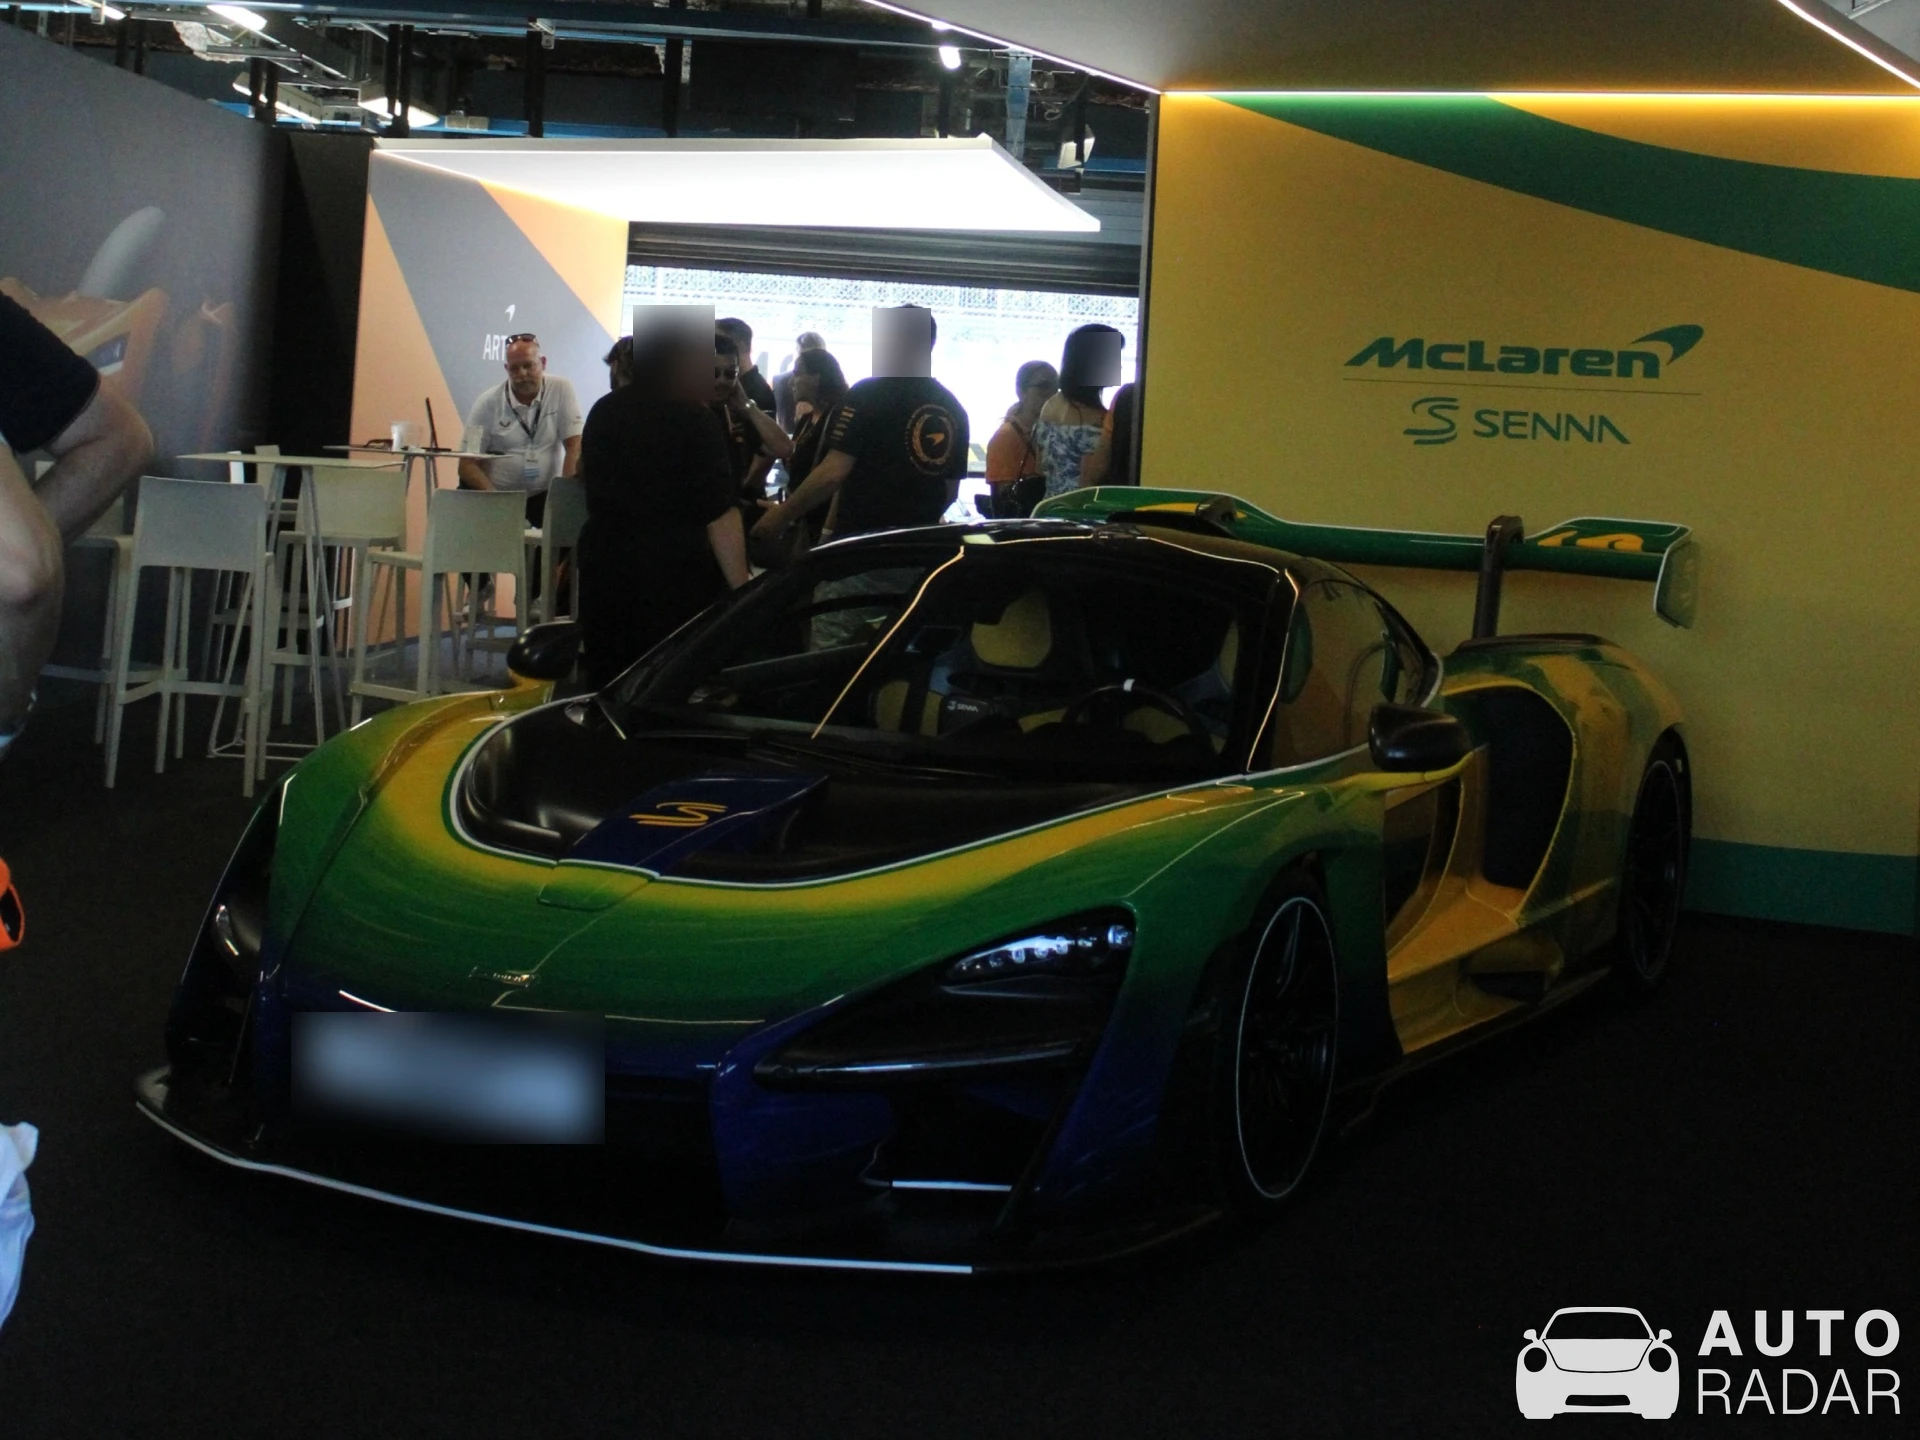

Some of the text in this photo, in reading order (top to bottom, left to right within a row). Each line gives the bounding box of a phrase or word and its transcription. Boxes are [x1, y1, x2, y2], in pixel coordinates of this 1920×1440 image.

[482, 333, 508, 361] ART
[1344, 337, 1660, 379] McLaren
[1473, 408, 1632, 445] SENNA
